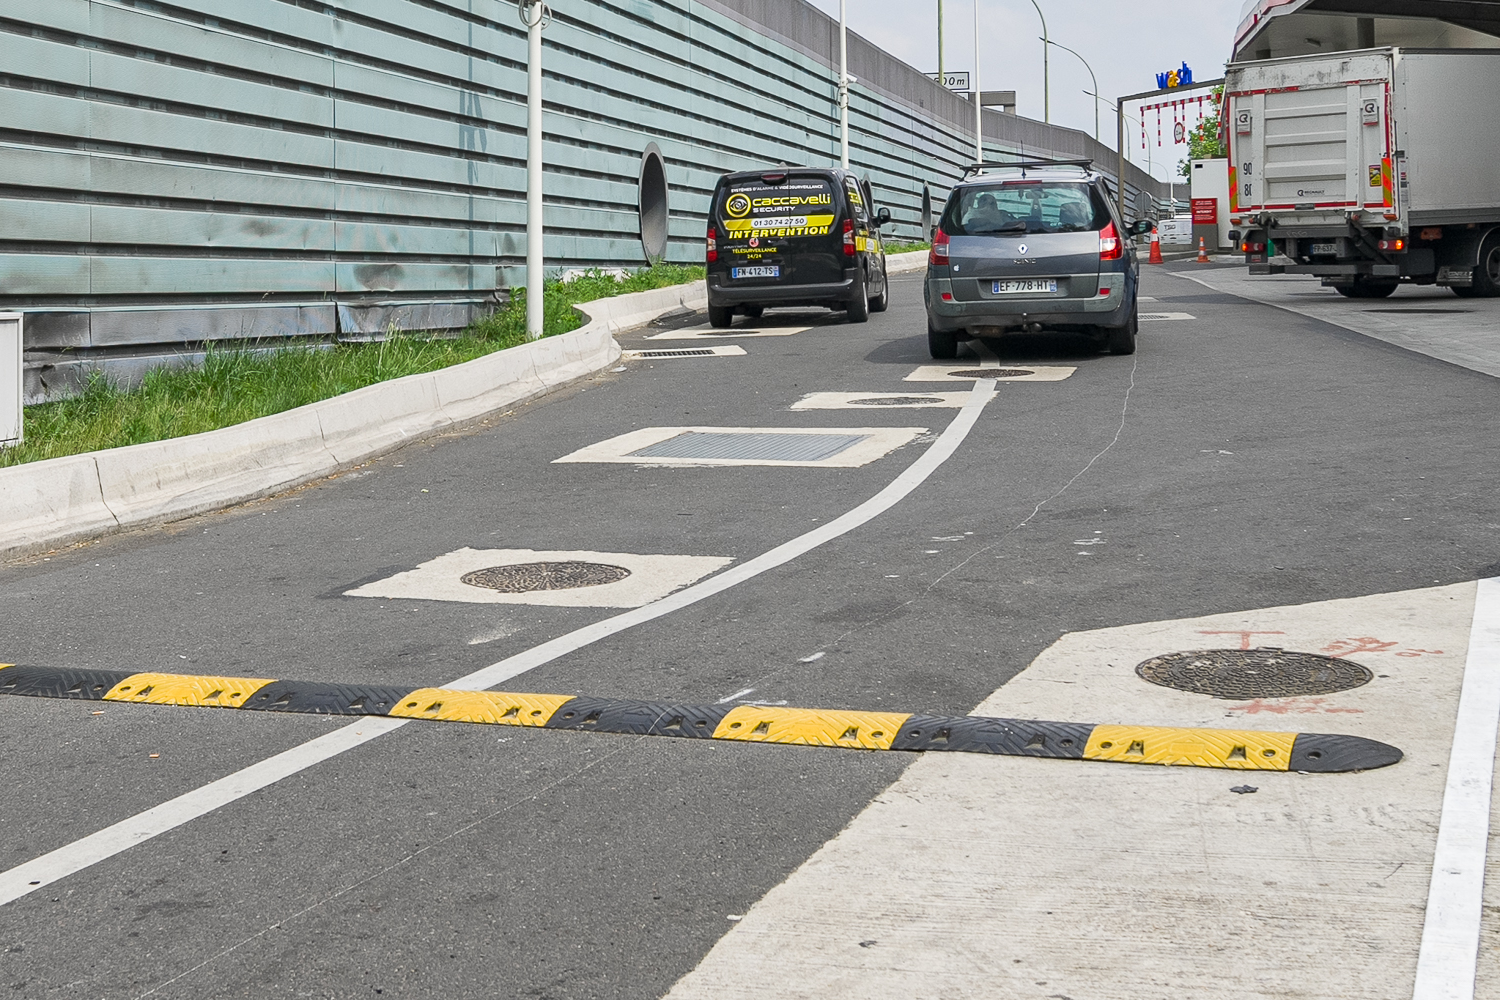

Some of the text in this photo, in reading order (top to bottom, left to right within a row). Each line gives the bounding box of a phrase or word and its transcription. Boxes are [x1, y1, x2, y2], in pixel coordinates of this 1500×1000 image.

[1243, 162, 1252, 175] 90
[728, 226, 829, 239] INTERVENTION
[737, 266, 773, 276] FN-412-TS
[999, 280, 1049, 292] EF-778-HT
